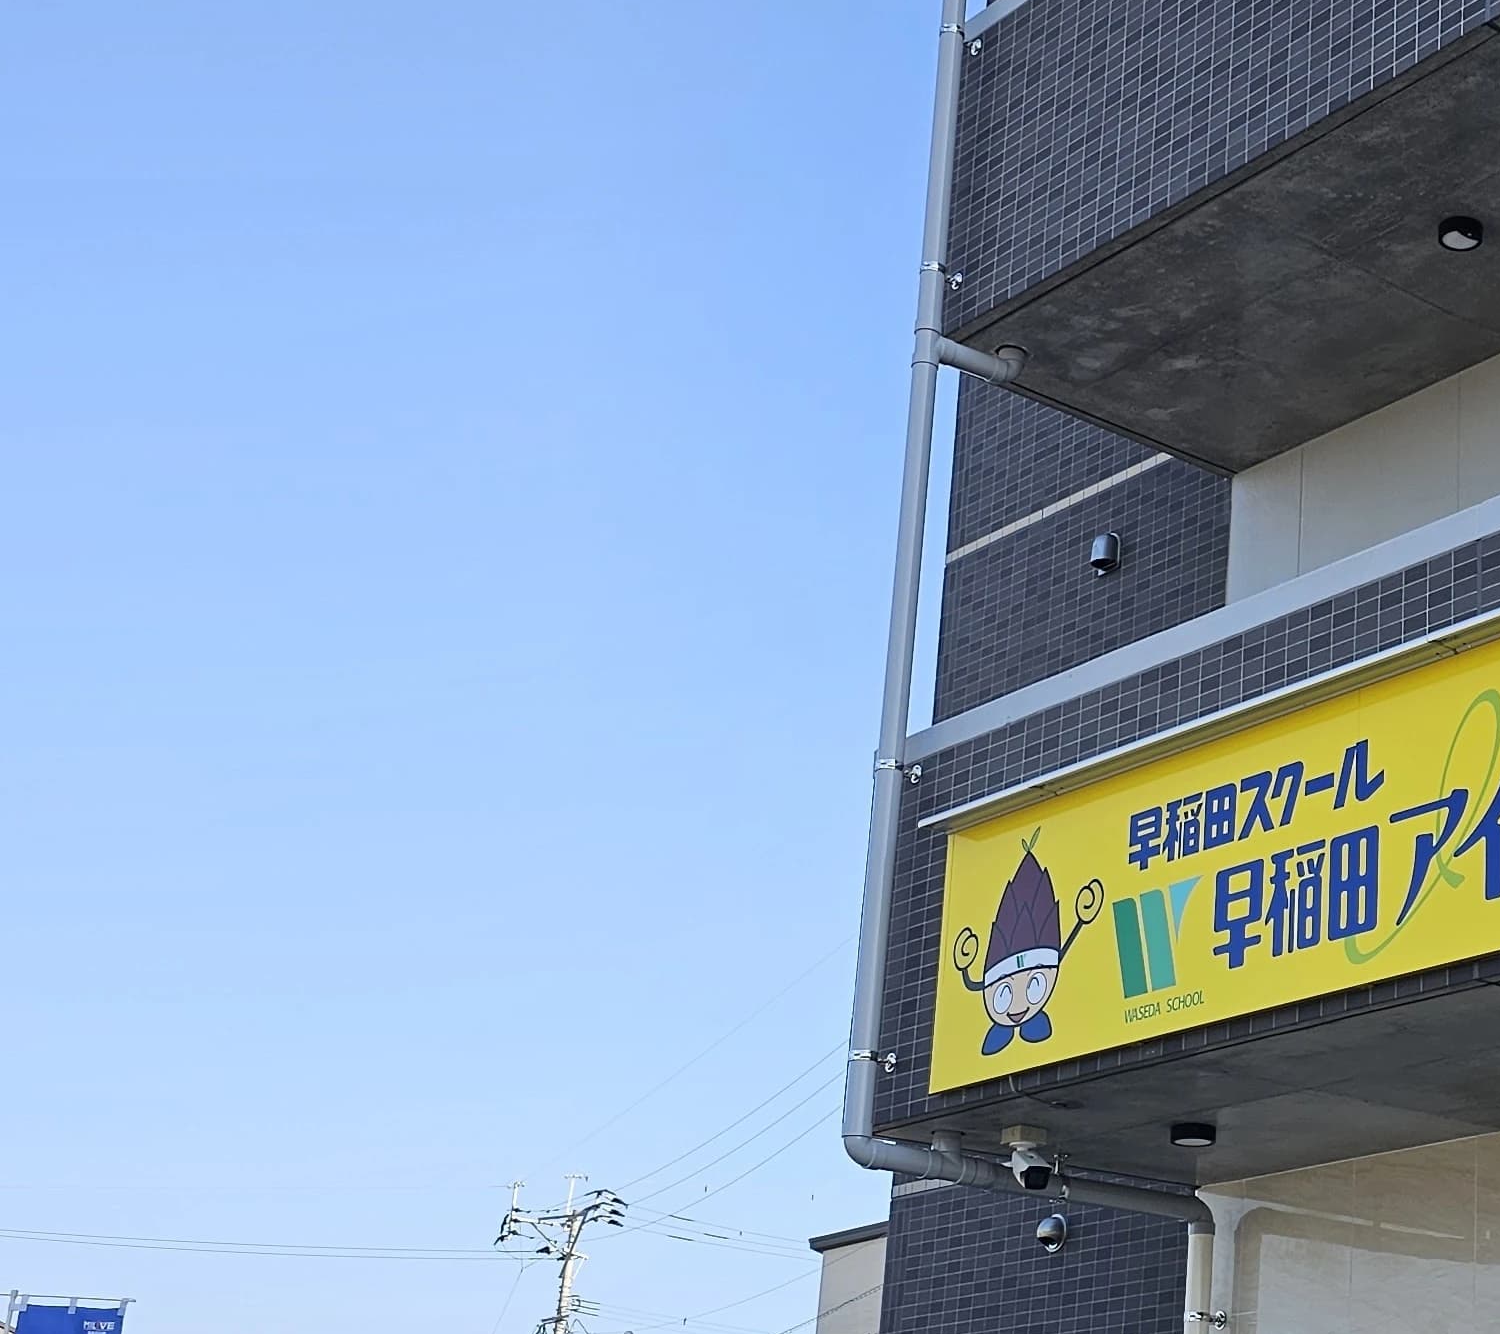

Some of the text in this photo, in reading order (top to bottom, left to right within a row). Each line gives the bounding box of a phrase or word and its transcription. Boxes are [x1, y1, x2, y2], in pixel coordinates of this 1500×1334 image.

[1127, 738, 1385, 871] 早稲田スクール
[1124, 990, 1205, 1024] WASEDA SCHOOL
